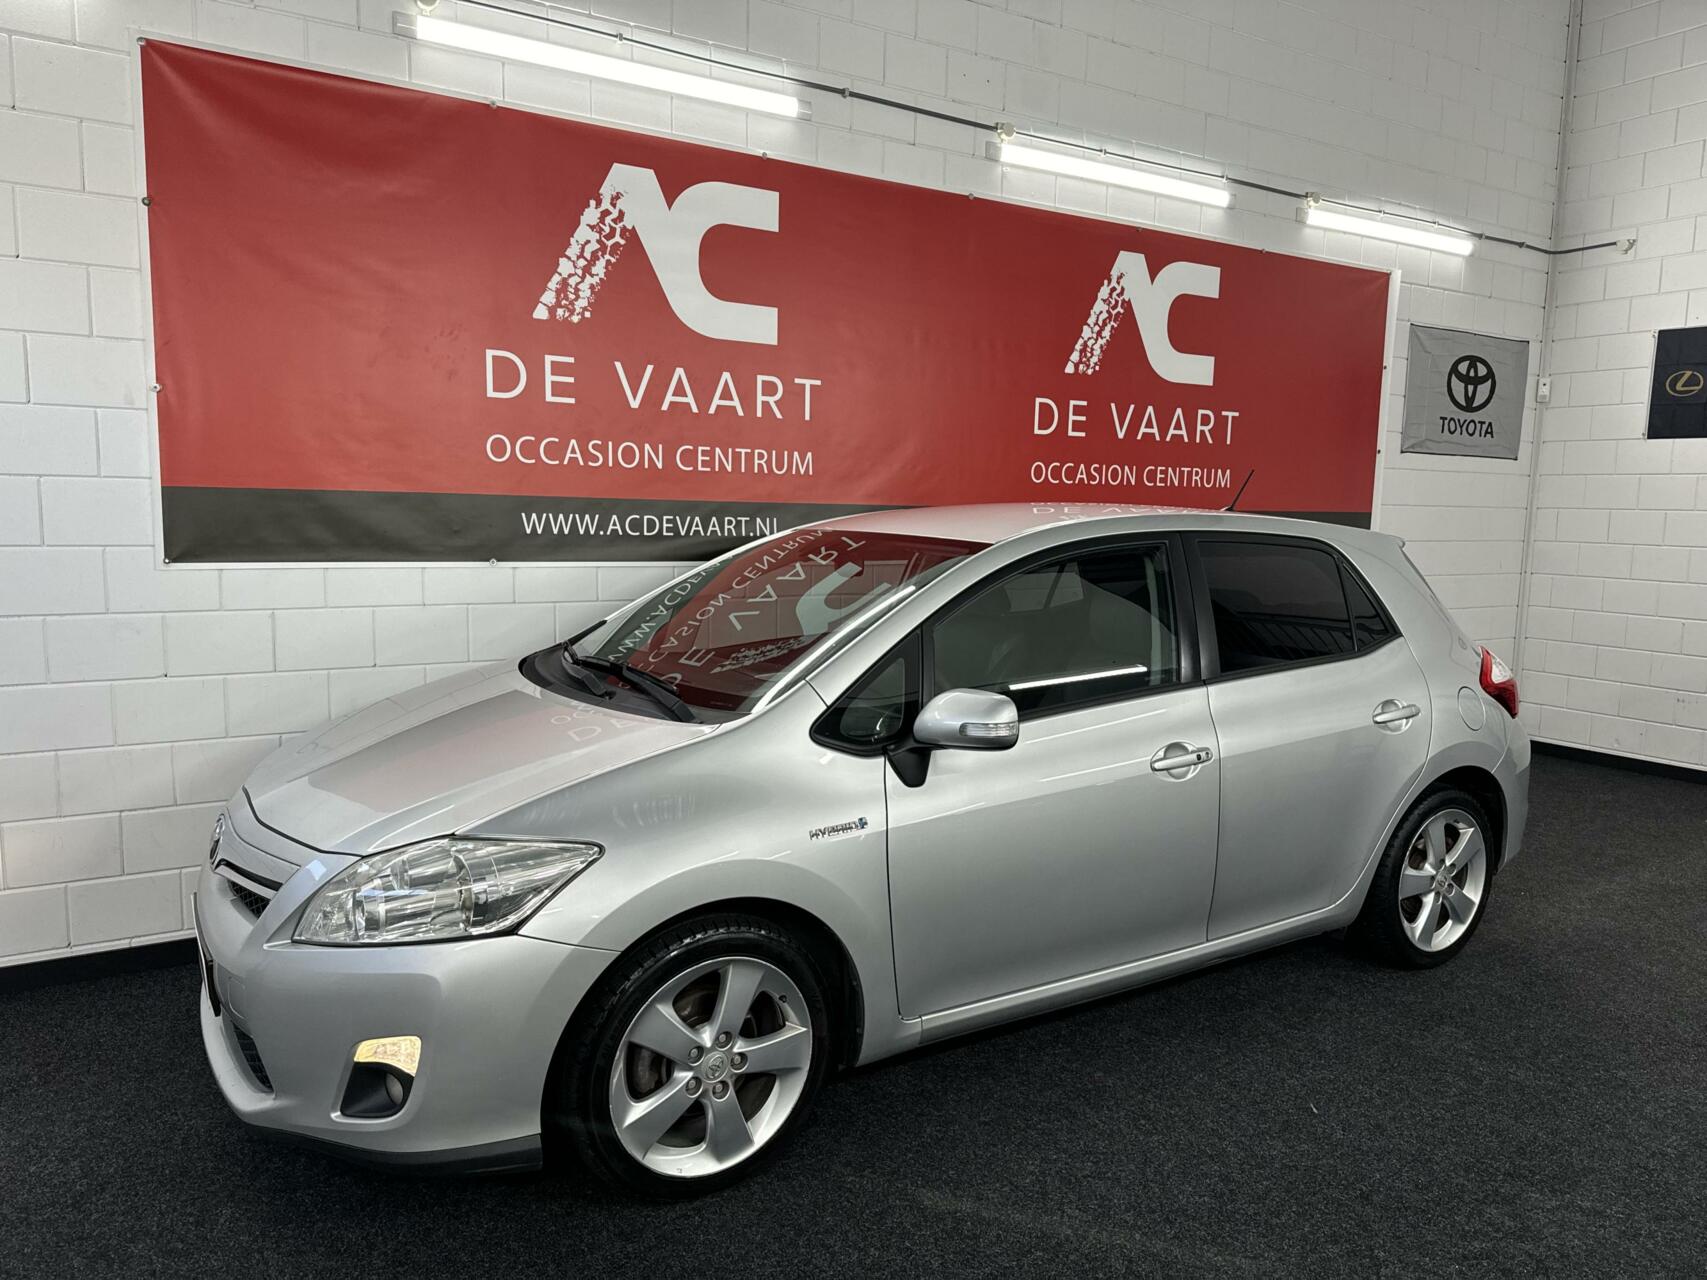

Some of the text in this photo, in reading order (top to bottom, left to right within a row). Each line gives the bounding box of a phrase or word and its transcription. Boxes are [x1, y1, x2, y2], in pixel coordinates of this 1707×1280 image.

[486, 349, 821, 420] DE VAART
[1034, 398, 1239, 444] DE VAART
[1439, 416, 1494, 438] TOYOTA
[487, 434, 812, 475] OCCASION CENTRUM
[1032, 462, 1229, 487] OCCASION CENTRUM
